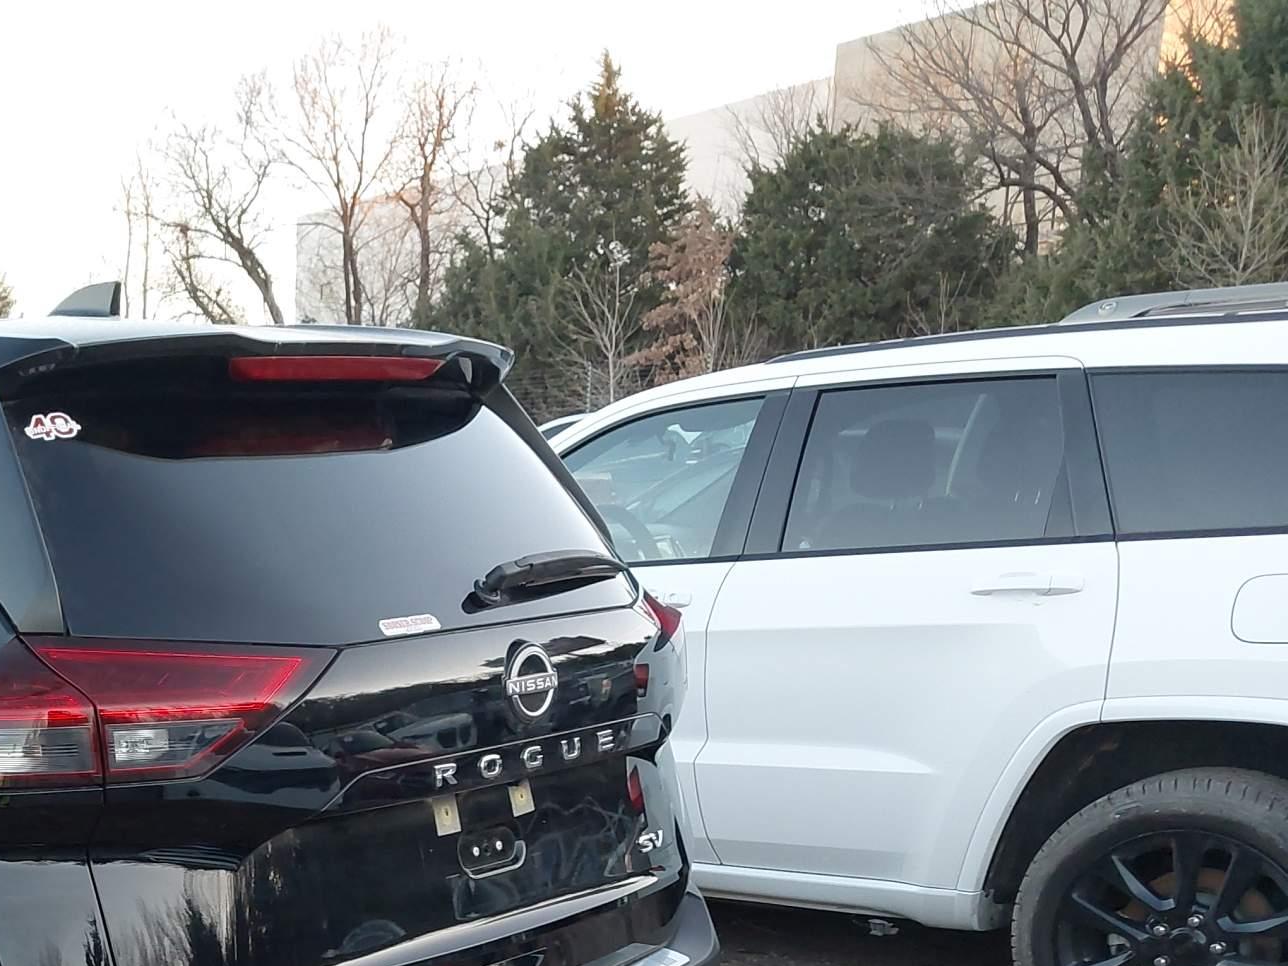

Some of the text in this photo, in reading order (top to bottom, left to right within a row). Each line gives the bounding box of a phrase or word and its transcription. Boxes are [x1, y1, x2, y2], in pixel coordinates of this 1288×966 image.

[508, 674, 558, 694] NISSAN
[433, 729, 615, 788] ROGUE
[637, 829, 664, 853] SV
